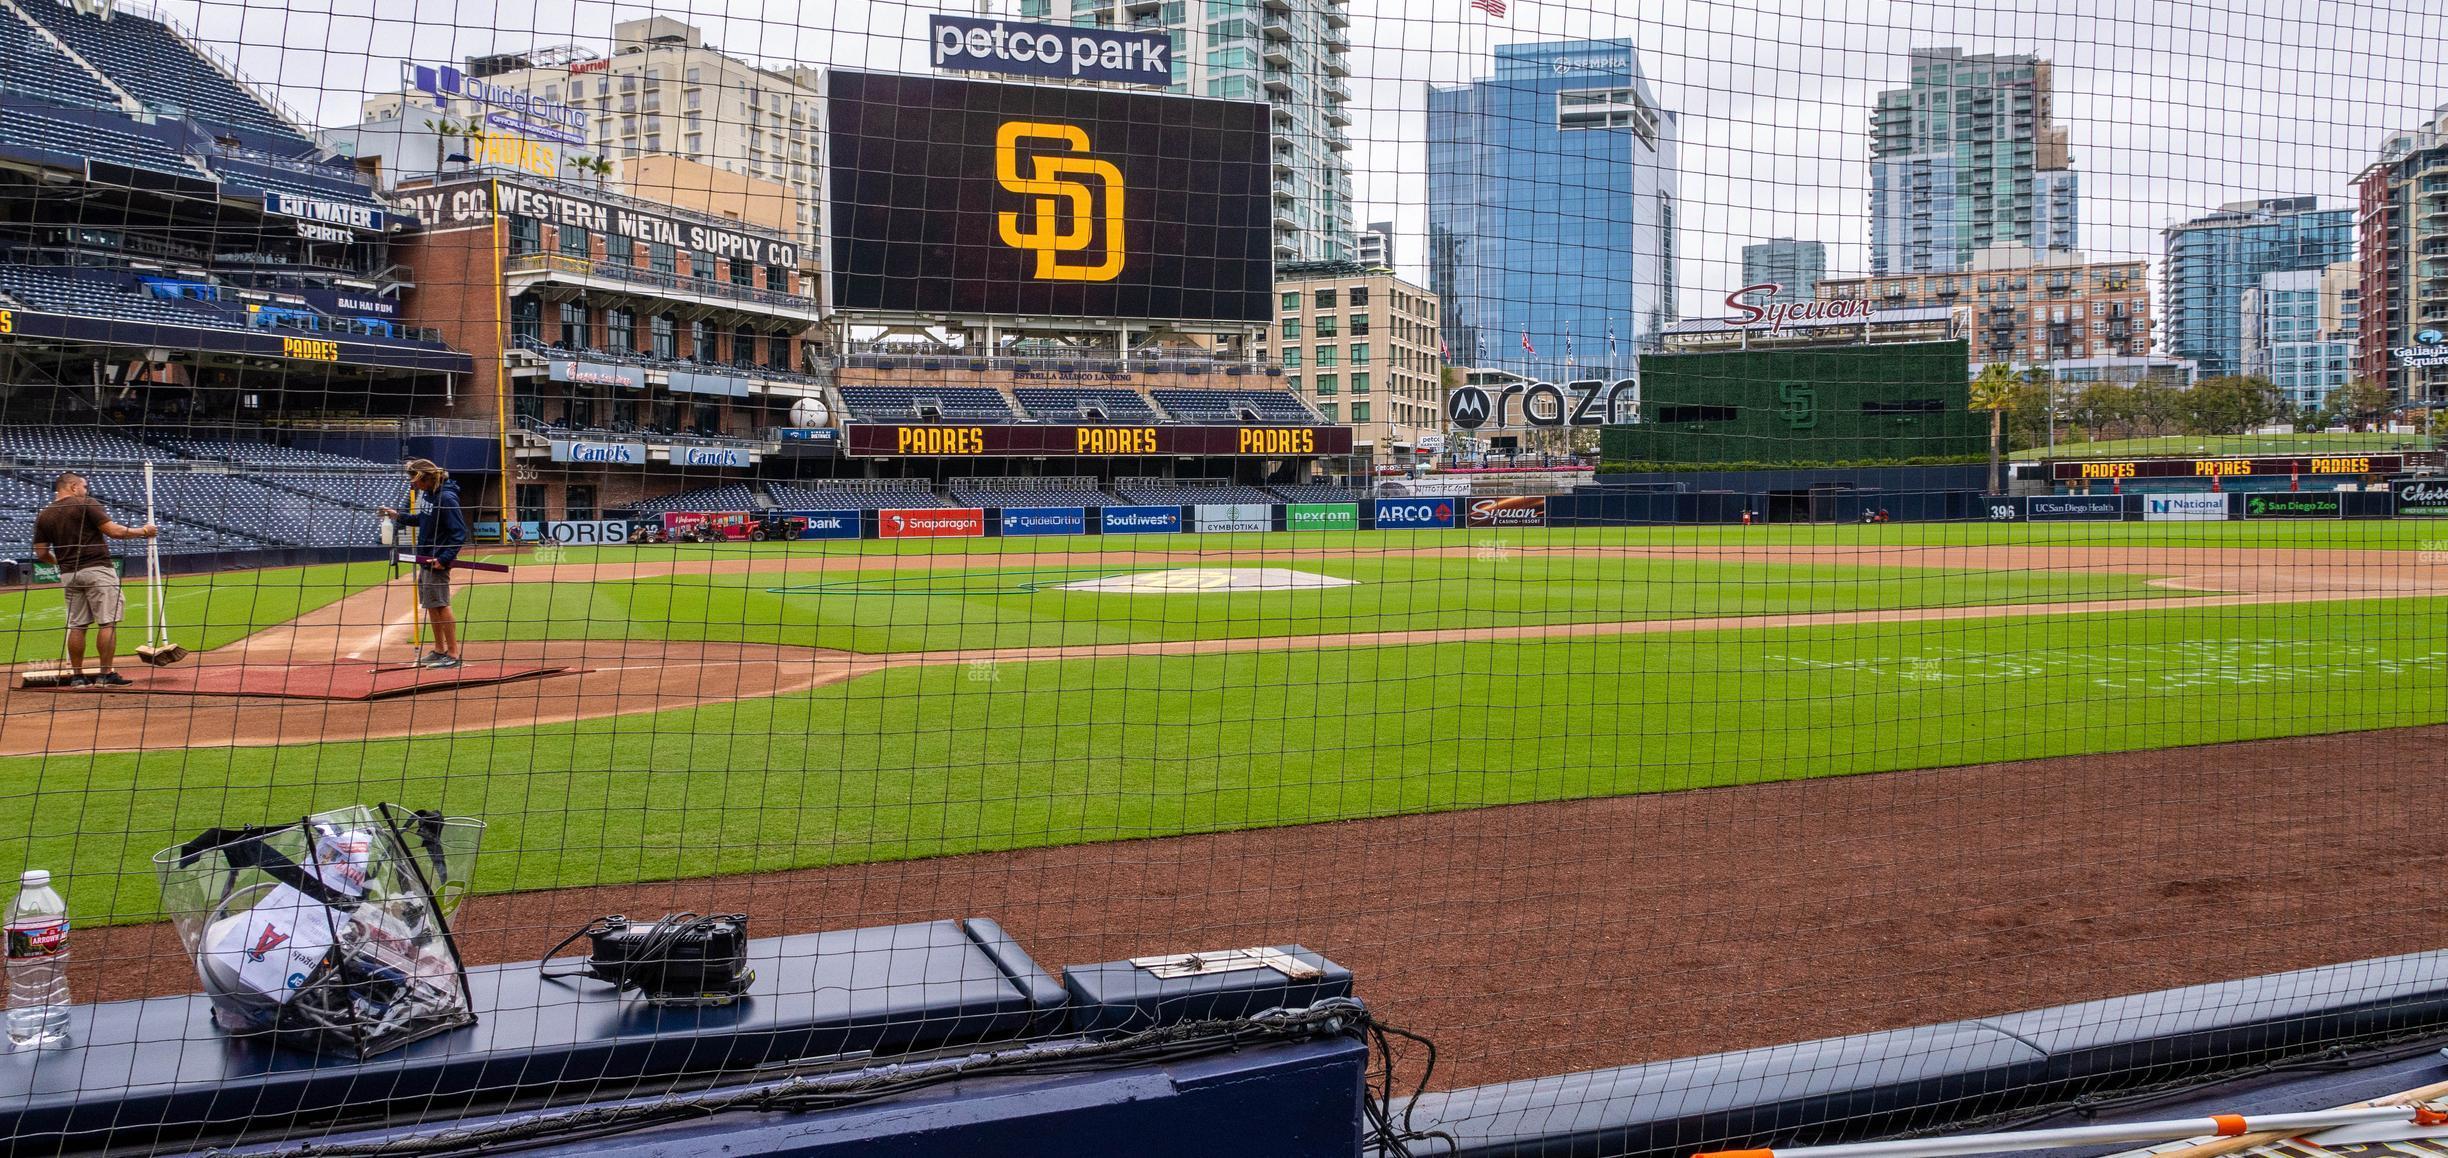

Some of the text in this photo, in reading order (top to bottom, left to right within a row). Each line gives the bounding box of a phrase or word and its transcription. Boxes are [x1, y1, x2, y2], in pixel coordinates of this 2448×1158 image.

[935, 22, 1168, 76] petco park
[1573, 58, 1627, 70] SEMPRA
[465, 76, 585, 129] QuidelOrtho
[473, 129, 555, 178] PADRES
[279, 193, 372, 228] CUTWATER
[297, 220, 354, 244] SPIRITS
[498, 184, 799, 268] WESTERN METAL SUPPLY CO.
[338, 298, 393, 314] BALI HAI RUM
[1724, 283, 1876, 334] Sycuan
[284, 337, 338, 361] PADRES
[1014, 372, 1057, 380] ESTRELLA
[1060, 373, 1093, 381] JALISCO
[1497, 378, 1637, 429] razr
[898, 427, 983, 454] PADRES
[1077, 427, 1157, 454] PADRES
[1240, 428, 1314, 454] PADRES
[572, 443, 631, 462] Canel's
[688, 447, 738, 465] Canel's
[2082, 463, 2135, 478] PADRES
[2196, 460, 2252, 476] PADRES
[2312, 458, 2370, 474] PADRES
[1471, 500, 1537, 525] Sycuan
[1990, 506, 2015, 519] 396
[2035, 504, 2114, 513] UC San Diego Health
[2174, 499, 2223, 509] National
[2288, 502, 2314, 512] Diego
[2316, 502, 2337, 510] Zoo
[1021, 516, 1080, 527] QuidelOrtho
[1106, 514, 1167, 526] Southwest
[1378, 506, 1432, 522] ARCO
[552, 523, 624, 543] ORIS
[910, 518, 977, 530] Snapdragon
[1207, 523, 1259, 531] CYMBIOTIKA
